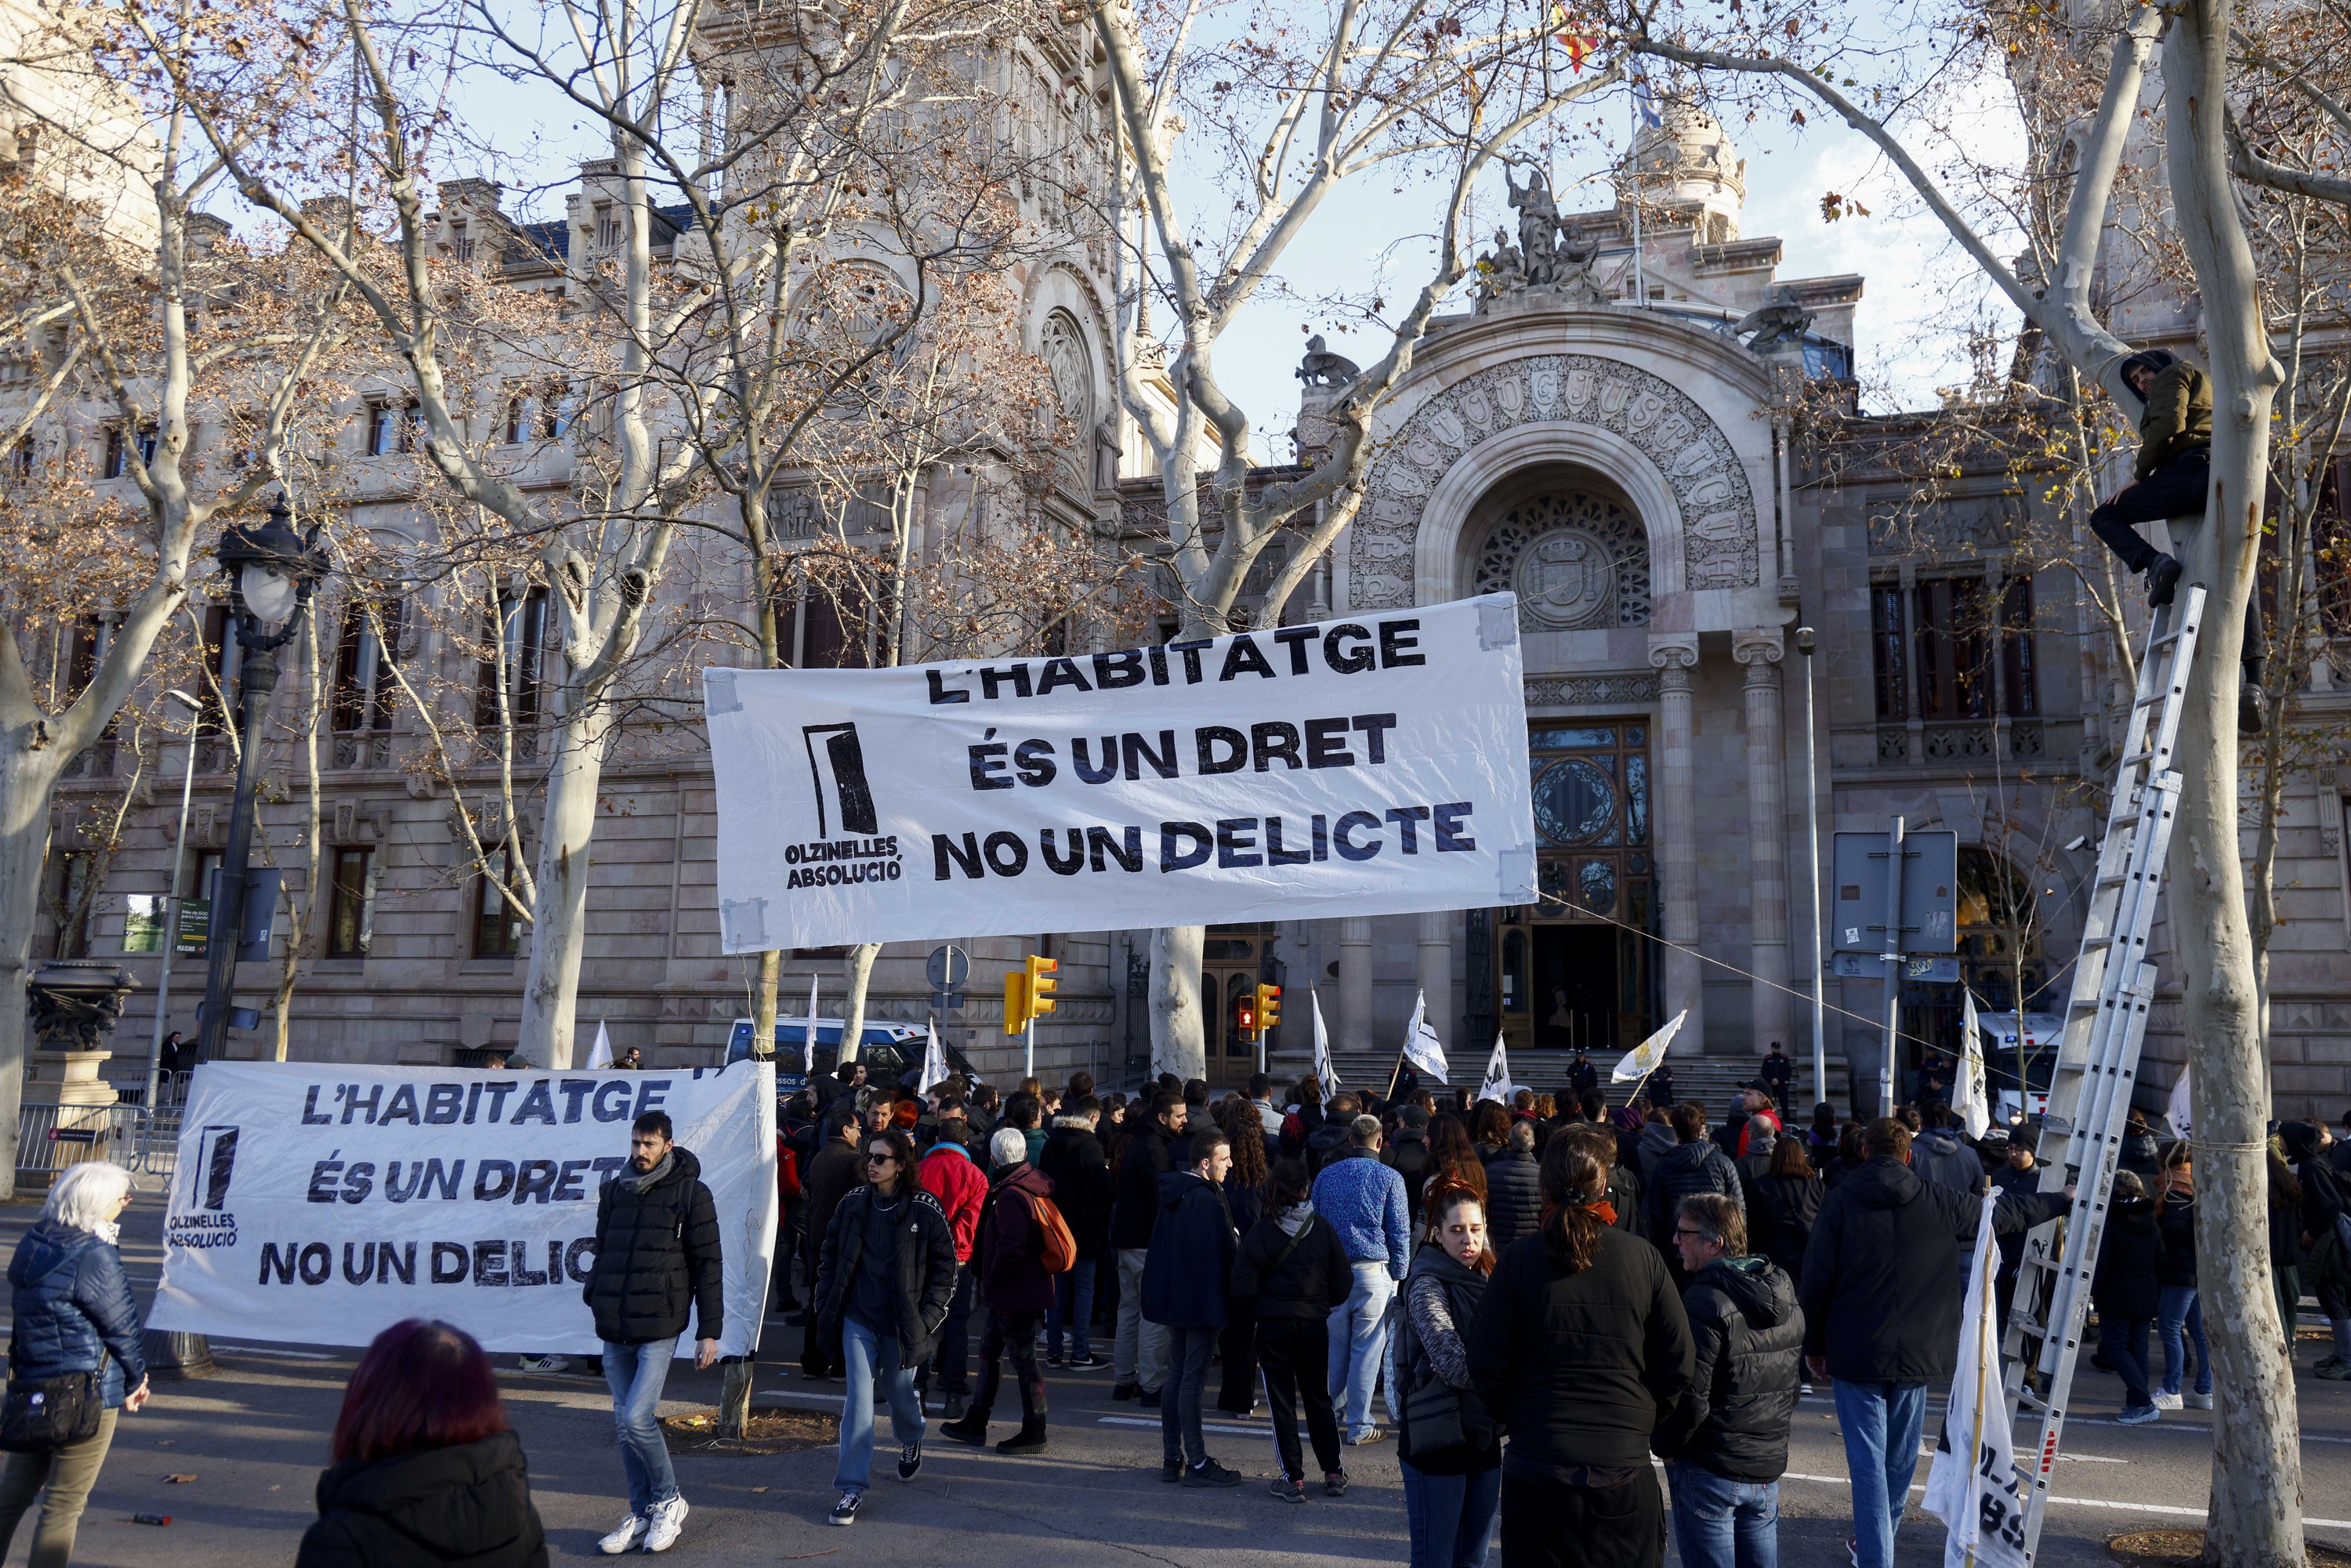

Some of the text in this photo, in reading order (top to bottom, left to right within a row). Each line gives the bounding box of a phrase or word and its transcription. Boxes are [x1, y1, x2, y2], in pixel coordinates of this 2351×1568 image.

[1365, 372, 1741, 599] PALACIO DE JUSTICIA
[925, 618, 1426, 704] L'HABITATGE
[968, 712, 1397, 791] ÉS UN DRET
[784, 835, 898, 864] OLZINELLES
[931, 801, 1476, 882] NO UN DELICTE
[786, 854, 904, 889] ABSOLUCIÓ
[301, 1078, 672, 1126] L'HABITATGE
[306, 1149, 626, 1205] ÉS UN DRET
[168, 1228, 238, 1249] ABSOLUCIÓ
[169, 1213, 235, 1230] OLZINELLES
[259, 1237, 597, 1287] NO UN DELIC
